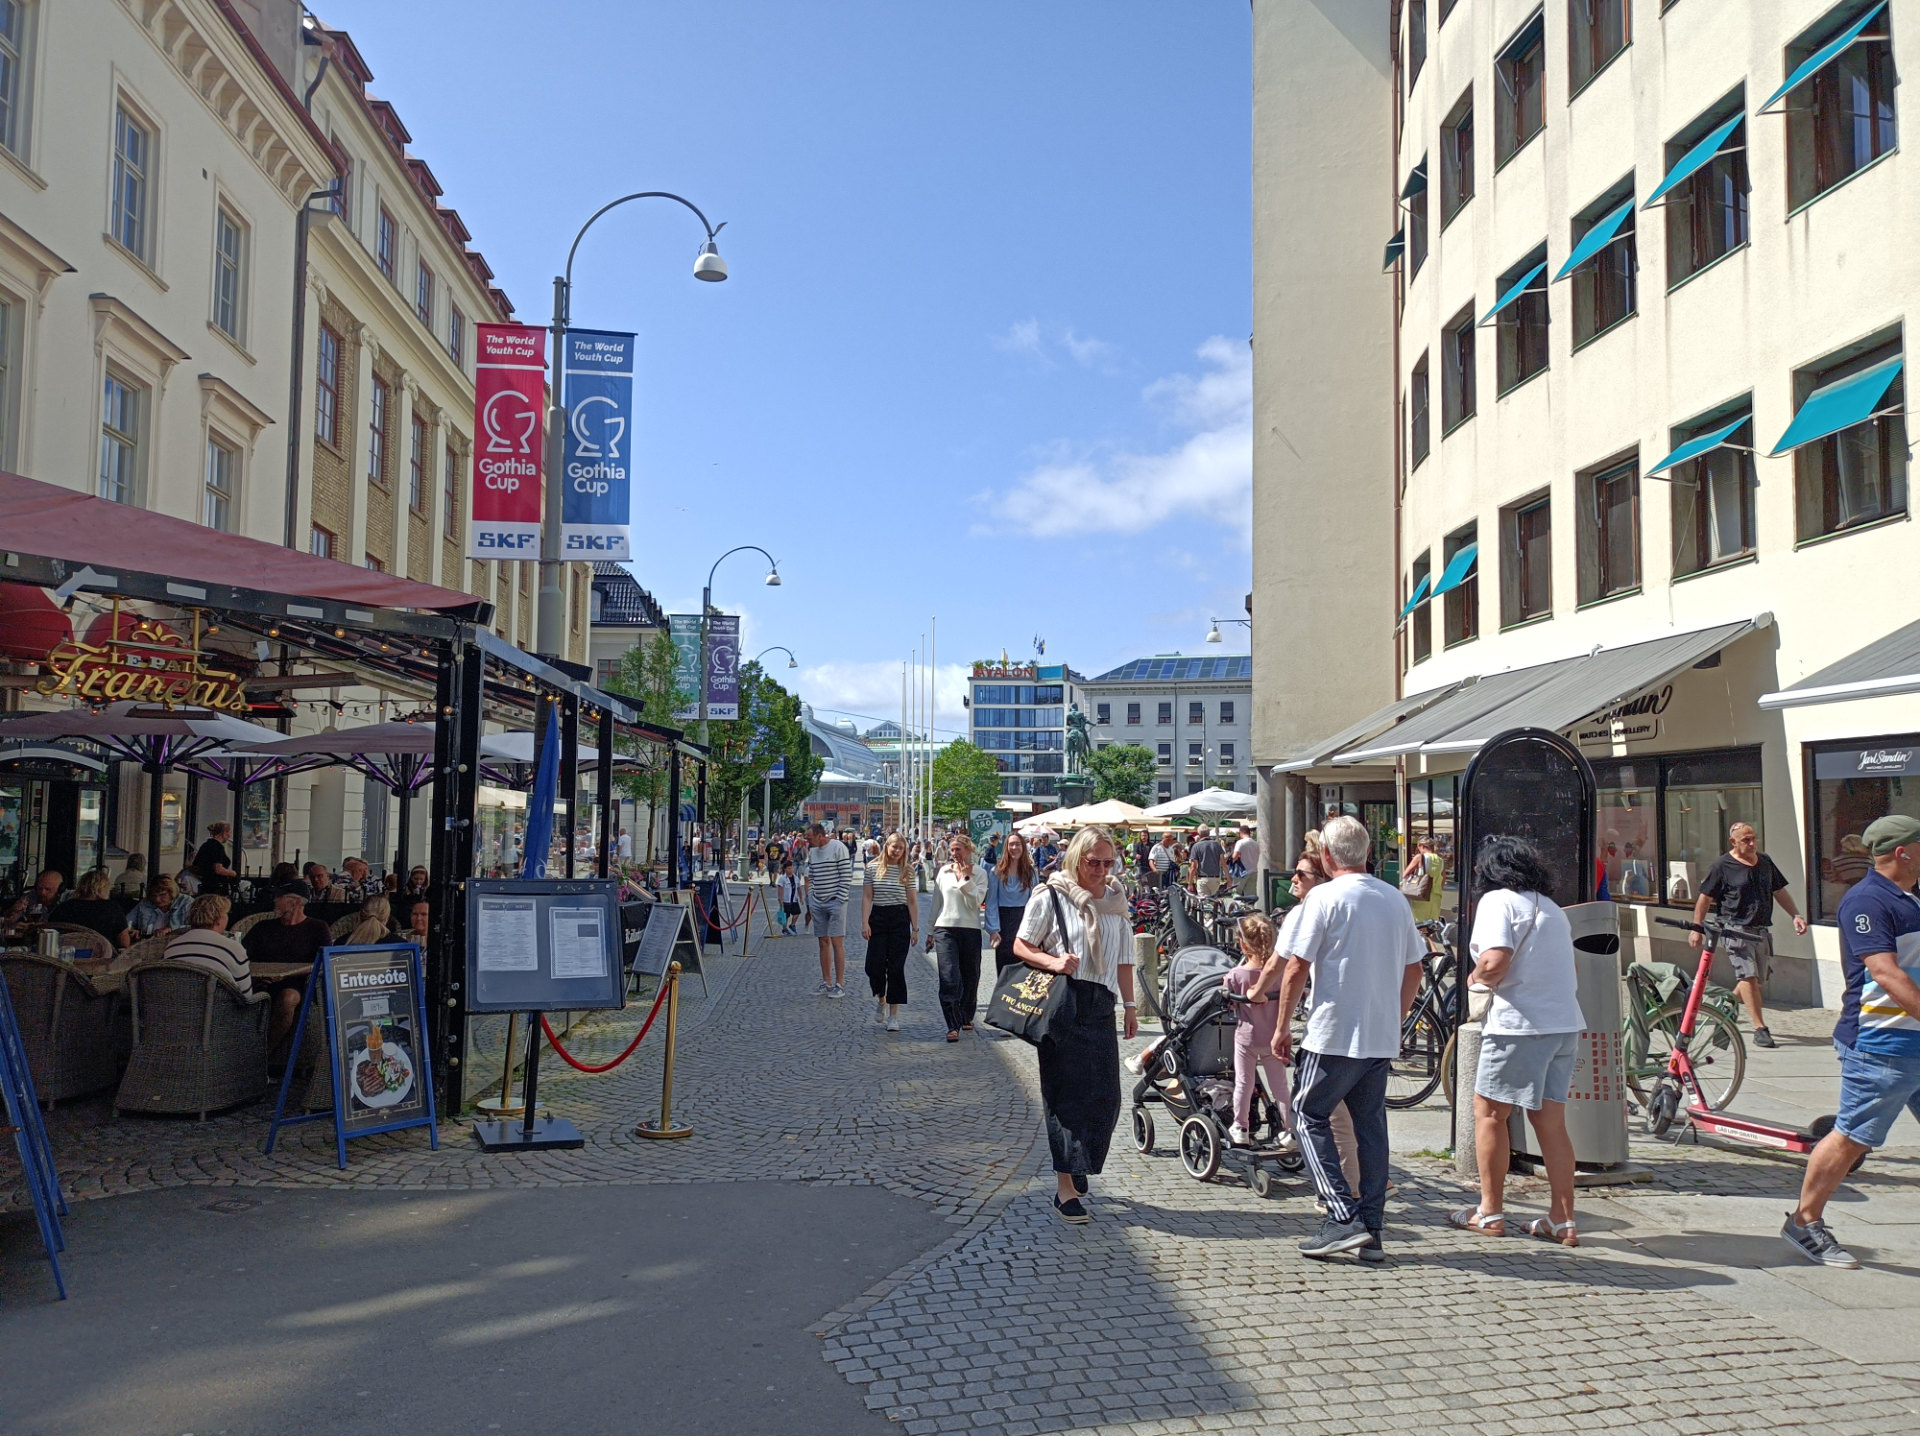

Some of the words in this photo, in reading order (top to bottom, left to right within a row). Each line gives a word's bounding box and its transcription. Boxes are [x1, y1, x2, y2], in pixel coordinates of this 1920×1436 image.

[486, 335, 504, 344] The
[505, 335, 535, 346] World
[574, 341, 593, 350] The
[594, 342, 624, 352] World
[486, 346, 513, 355] Youth
[515, 347, 535, 358] Cup
[574, 352, 602, 362] Youth
[603, 354, 624, 365] Cup
[478, 457, 537, 476] Gothia
[567, 461, 626, 480] Gothia
[485, 474, 520, 494] Cup
[573, 477, 609, 497] Cup
[477, 532, 535, 549] SKF
[566, 535, 625, 551] SKF
[111, 652, 140, 667] LE
[150, 655, 209, 675] PAIN
[973, 666, 1034, 678] AVALON
[710, 675, 737, 684] Gothia
[713, 682, 730, 691] Cup
[710, 707, 737, 716] SKF
[974, 819, 992, 829] 150
[1855, 914, 1872, 934] 3
[339, 969, 407, 988] Entrecôte
